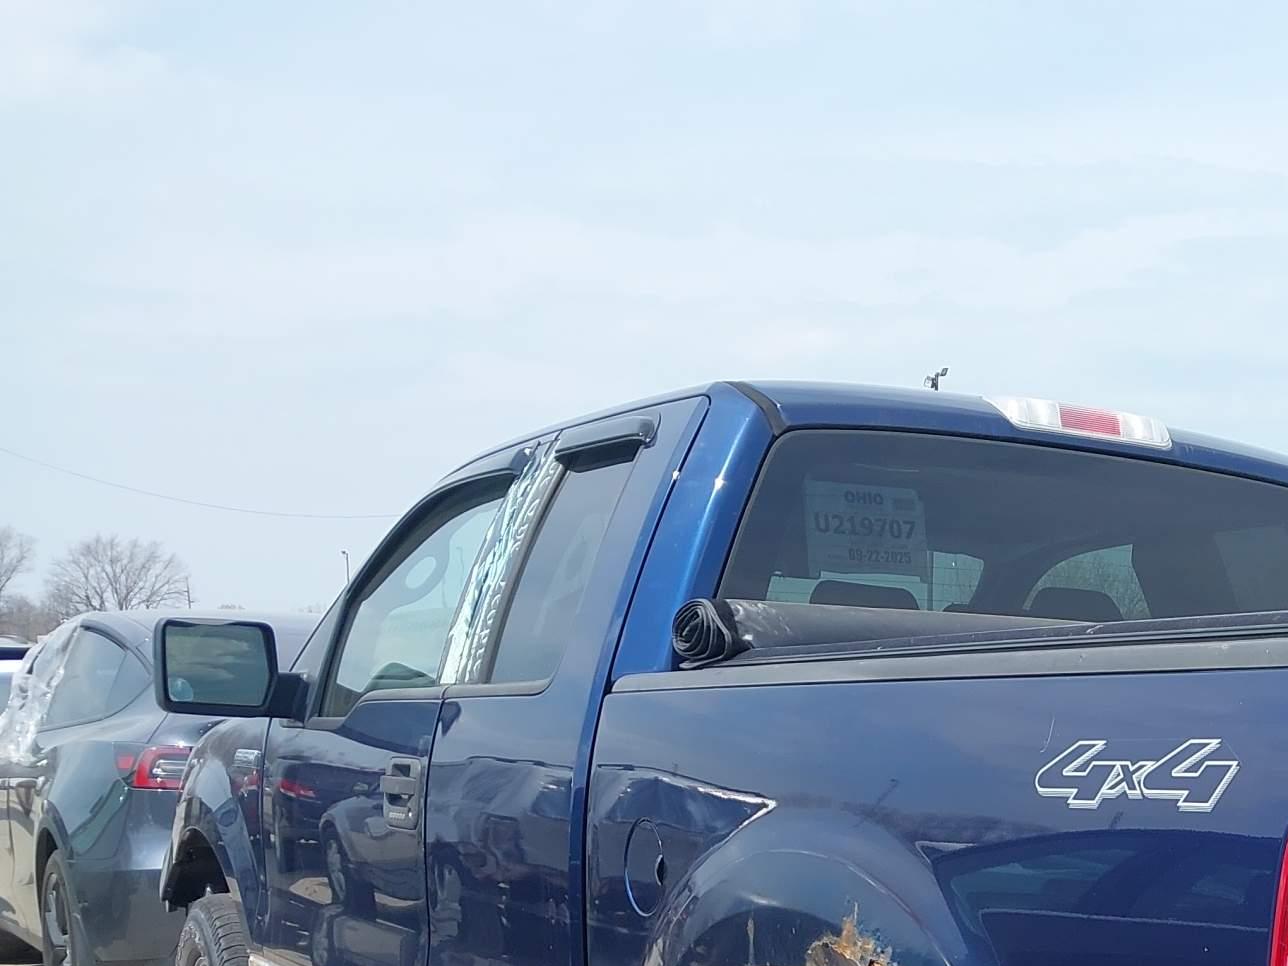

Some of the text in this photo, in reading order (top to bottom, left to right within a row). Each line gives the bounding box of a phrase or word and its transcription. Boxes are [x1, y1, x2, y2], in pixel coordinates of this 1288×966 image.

[844, 490, 884, 505] OHIO
[814, 512, 916, 540] U219707
[1035, 739, 1240, 812] 4x4
